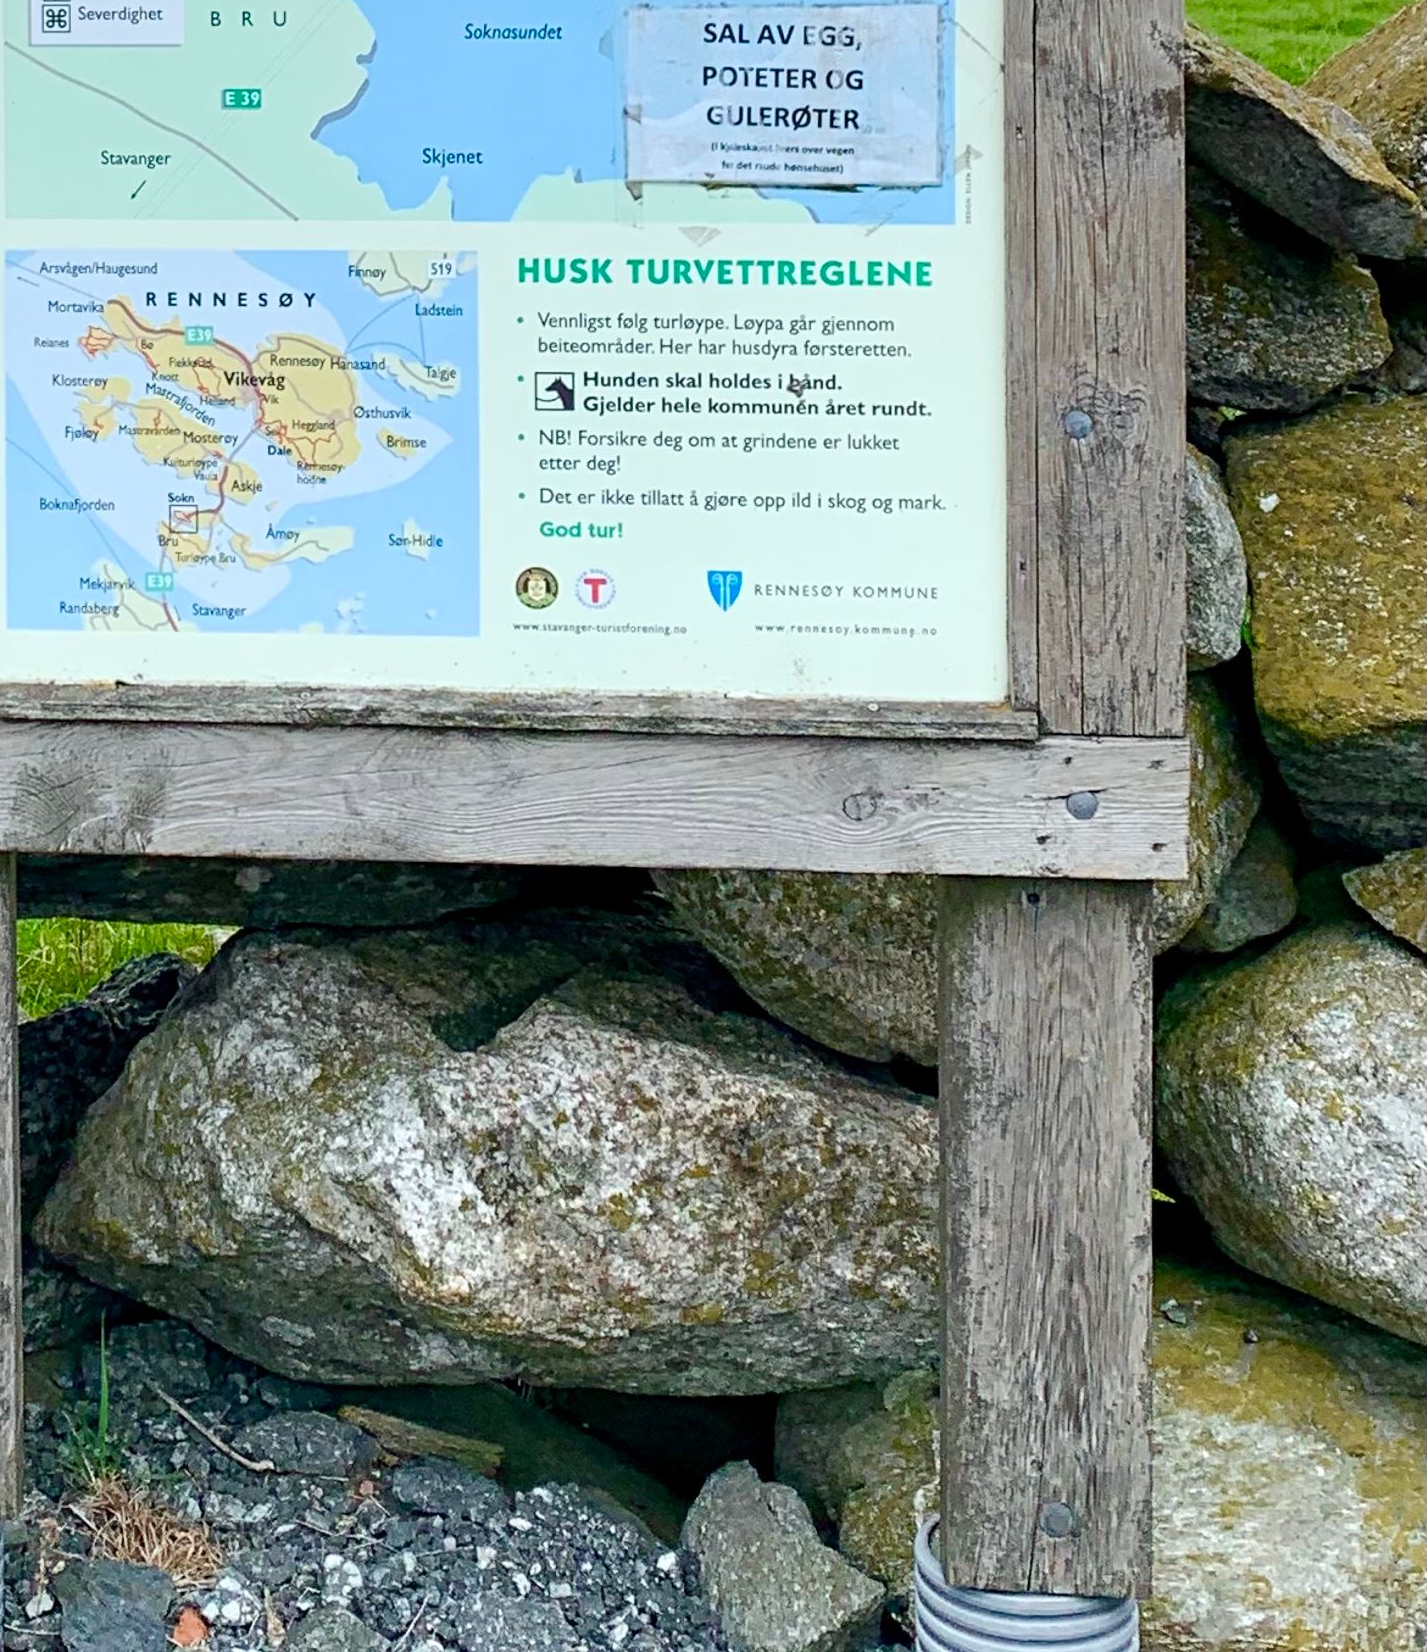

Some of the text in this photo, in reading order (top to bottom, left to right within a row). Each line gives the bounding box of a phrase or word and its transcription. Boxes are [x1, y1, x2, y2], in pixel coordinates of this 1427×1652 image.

[77, 6, 163, 25] Severdighet
[464, 23, 563, 40] Soknasundet
[703, 23, 864, 51] SAL AV EGG,
[702, 66, 864, 91] POTETER OG
[225, 91, 261, 107] E 39
[706, 105, 859, 131] GULERØTER
[100, 150, 171, 168] Stavanger
[422, 147, 484, 168] Skjenet
[348, 265, 387, 281] Finnøy
[430, 262, 453, 276] 519
[518, 257, 933, 288] HUSK TURVETTREGLENE
[48, 300, 105, 313] Mortavika
[415, 303, 463, 317] Ladstein
[537, 311, 895, 336] Vennligst følg turløype. Løypa går gjennom
[537, 337, 913, 360] beiteområder. Her har husdyra førsteretten.
[270, 353, 326, 370] Rennesøy
[330, 357, 386, 371] Hanasand
[52, 374, 108, 388] Klosterøy
[223, 370, 286, 391] Vikevåg
[583, 372, 660, 389] Hunden
[665, 373, 703, 390] skal
[708, 374, 772, 390] holdes
[777, 375, 783, 390] i
[353, 405, 411, 419] Østhusvik
[583, 397, 933, 419] Gjelder hele kommunen året rundt.
[65, 425, 99, 441] Fjøløy
[183, 432, 239, 448] Mosterøy
[387, 435, 427, 448] Brimse
[538, 430, 900, 453] NB! Forsikre deg om at grindene er lukket
[267, 445, 293, 456] Dale
[538, 455, 622, 476] etter deg!
[231, 480, 263, 495] Askje
[39, 497, 115, 514] Boknafjorden
[168, 492, 195, 503] Sokn
[538, 489, 947, 515] Det er ikke tillatt å gjøre opp ild i skog og mark.
[265, 522, 300, 543] Åmøy
[539, 522, 624, 540] God tur!
[158, 534, 179, 547] Bru
[79, 577, 135, 591] Mekjarvik
[754, 583, 939, 600] RENNESØY KOMMUNE
[59, 601, 120, 618] Randaberg
[192, 603, 247, 620] Stavanger
[512, 622, 688, 637] www.stavanger-turistforening.no
